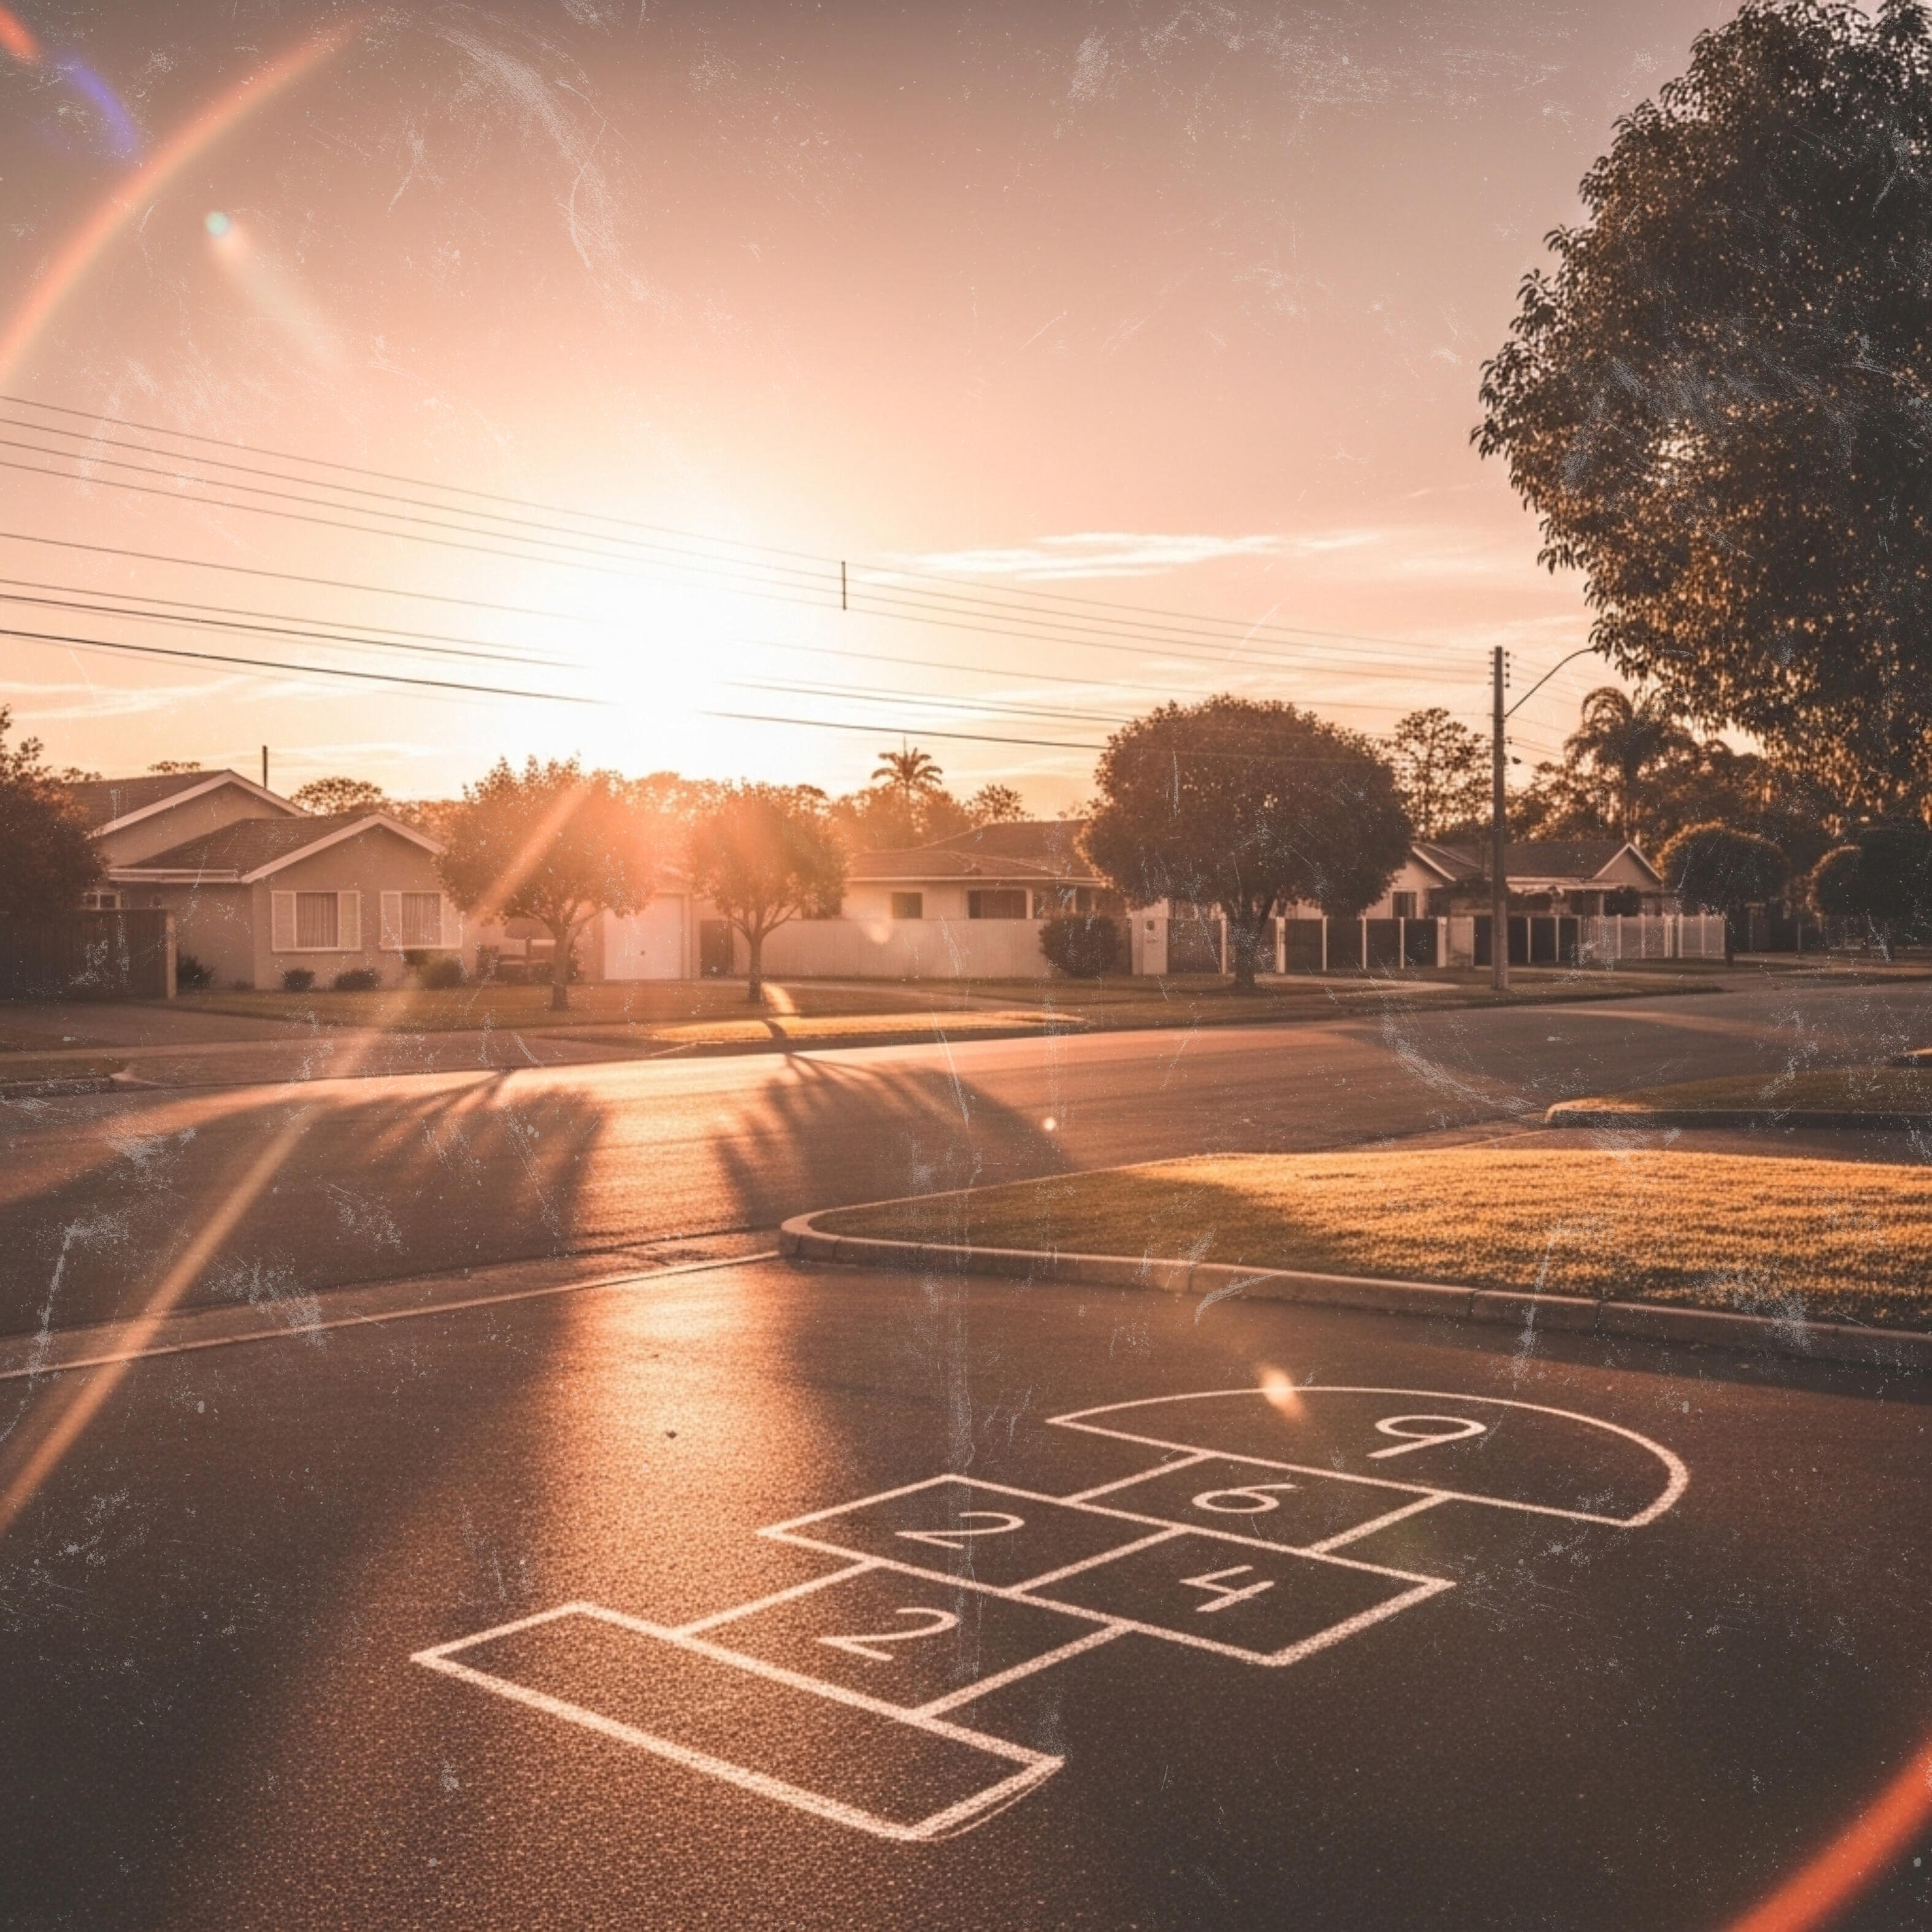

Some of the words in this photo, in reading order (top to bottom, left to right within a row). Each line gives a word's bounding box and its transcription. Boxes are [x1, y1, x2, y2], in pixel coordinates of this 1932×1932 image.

[1366, 1414, 1487, 1459] 9
[1192, 1483, 1297, 1513] 6
[894, 1511, 1025, 1549] 2
[1179, 1565, 1275, 1612] 4
[815, 1608, 960, 1660] 2
